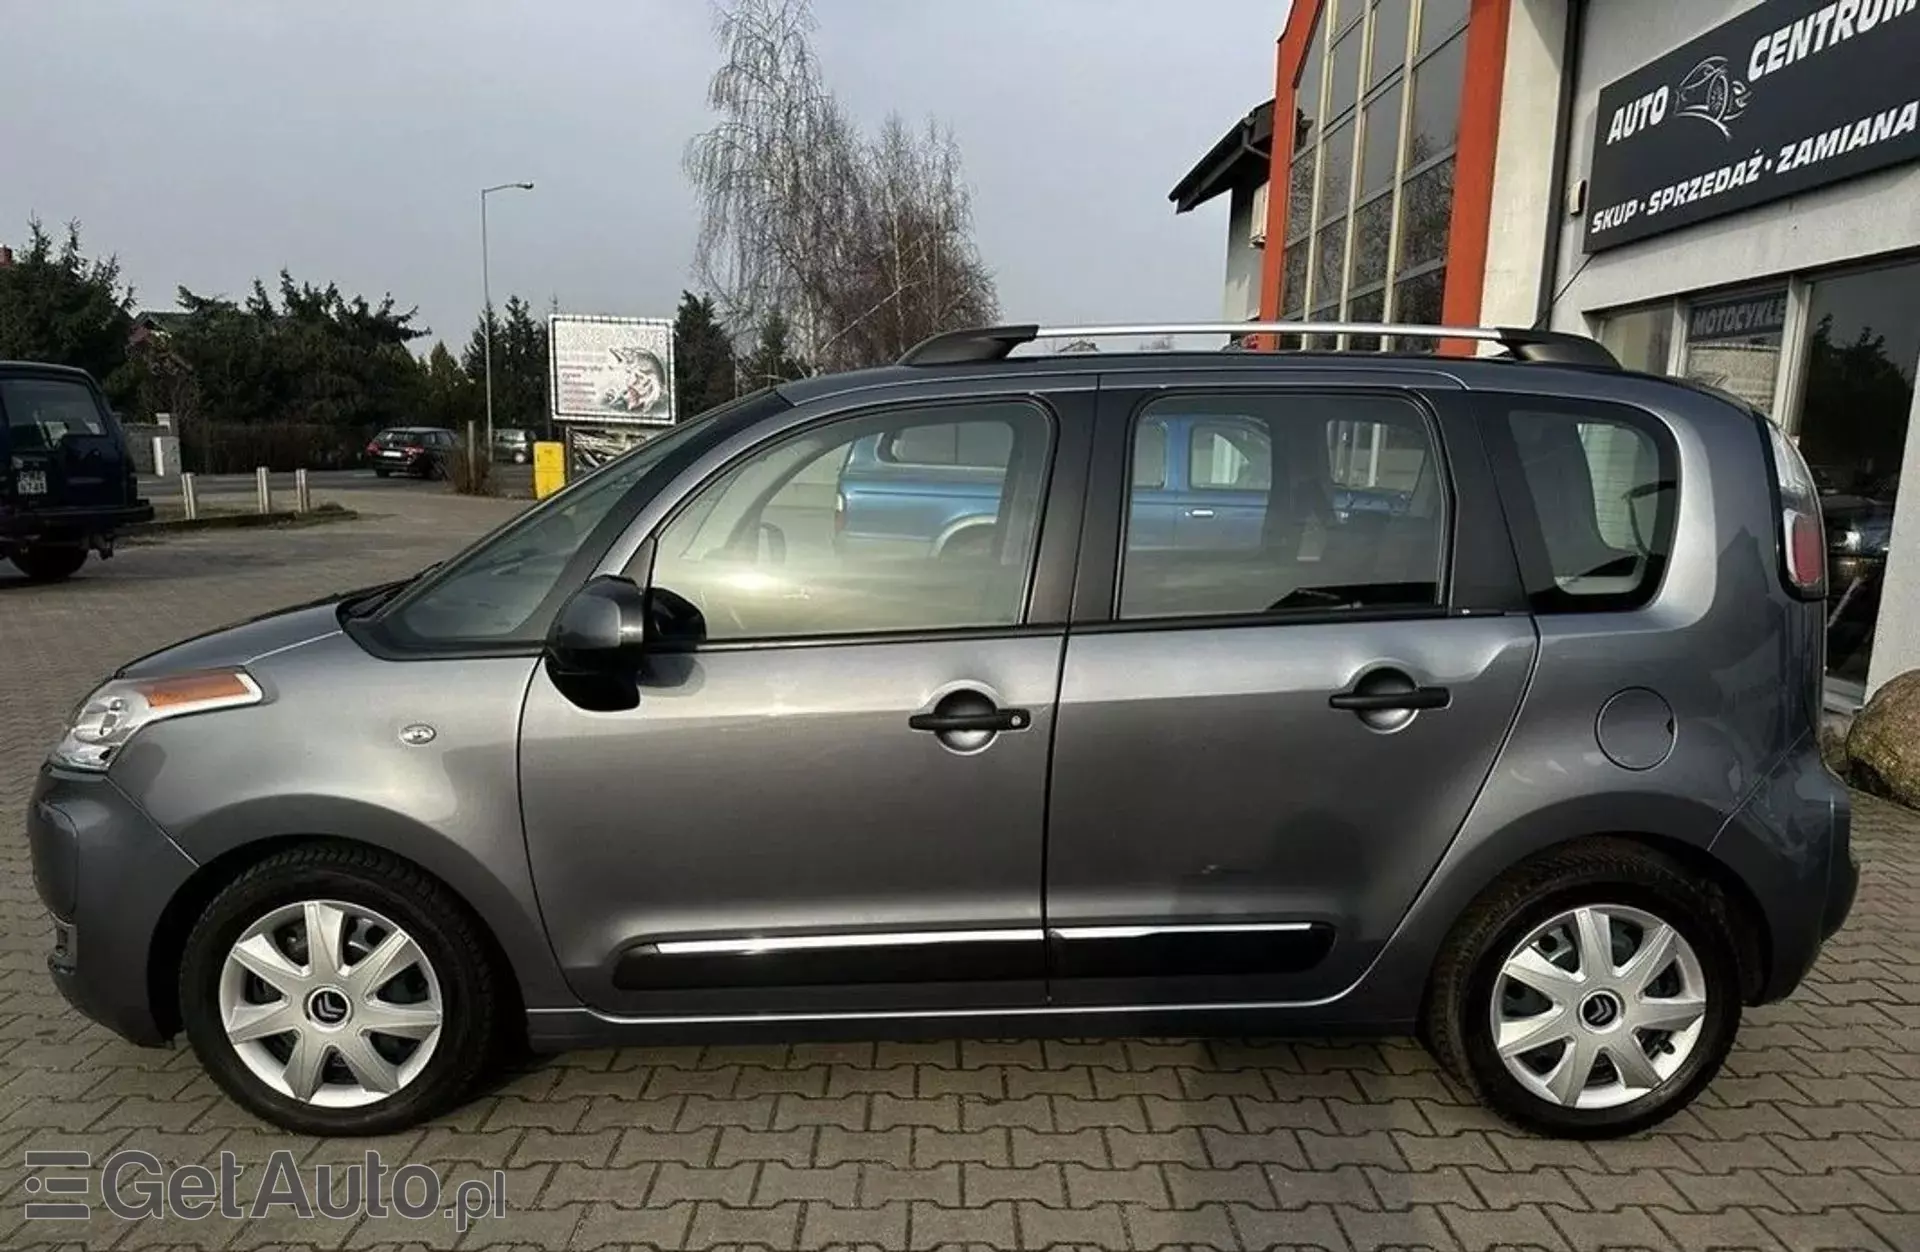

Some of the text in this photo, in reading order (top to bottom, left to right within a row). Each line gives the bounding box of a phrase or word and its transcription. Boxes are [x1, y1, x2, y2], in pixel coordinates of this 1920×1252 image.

[1606, 85, 1668, 145] AUTO
[1591, 100, 1919, 234] SKUP SPRZEDAŻ ZAMIANA
[1691, 298, 1787, 336] MOTOCYKLE
